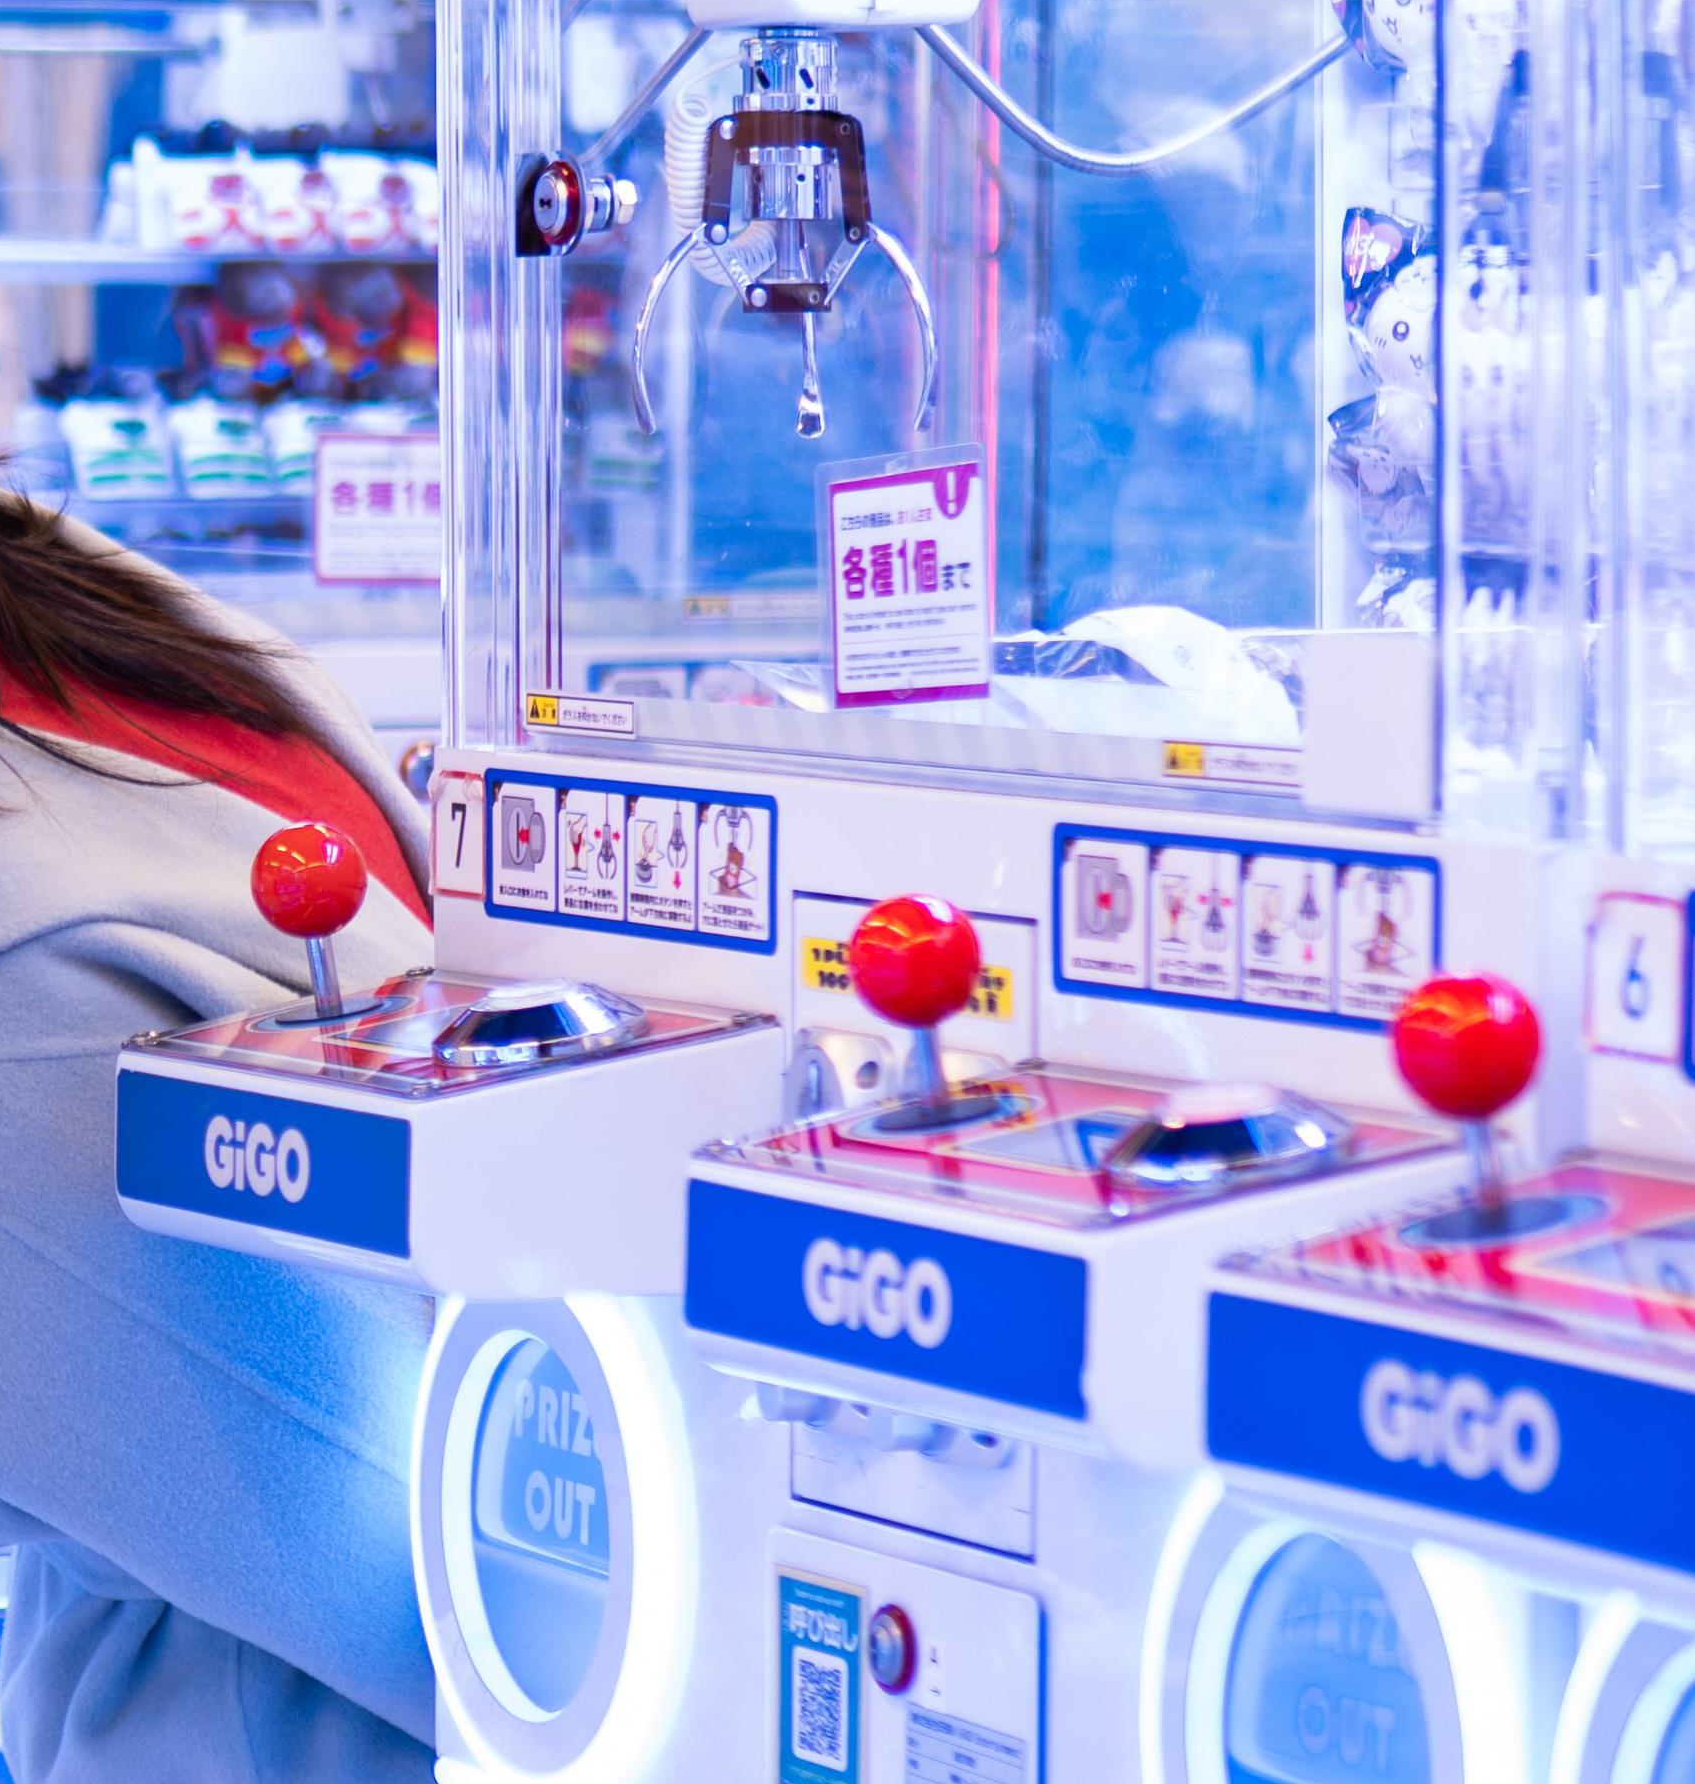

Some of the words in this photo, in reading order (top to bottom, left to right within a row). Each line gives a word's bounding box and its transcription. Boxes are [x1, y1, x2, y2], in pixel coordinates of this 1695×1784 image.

[842, 538, 972, 600] 各種1個まで
[451, 802, 467, 869] 7
[1618, 935, 1651, 1020] 6
[205, 1116, 310, 1203] GiGO
[802, 1237, 952, 1348] GiGO
[514, 1379, 598, 1457] PRIZ
[1360, 1359, 1561, 1494] GiGO
[525, 1470, 596, 1546] OUT
[788, 1602, 858, 1652] 呼び出し
[1297, 1684, 1397, 1774] OUT
